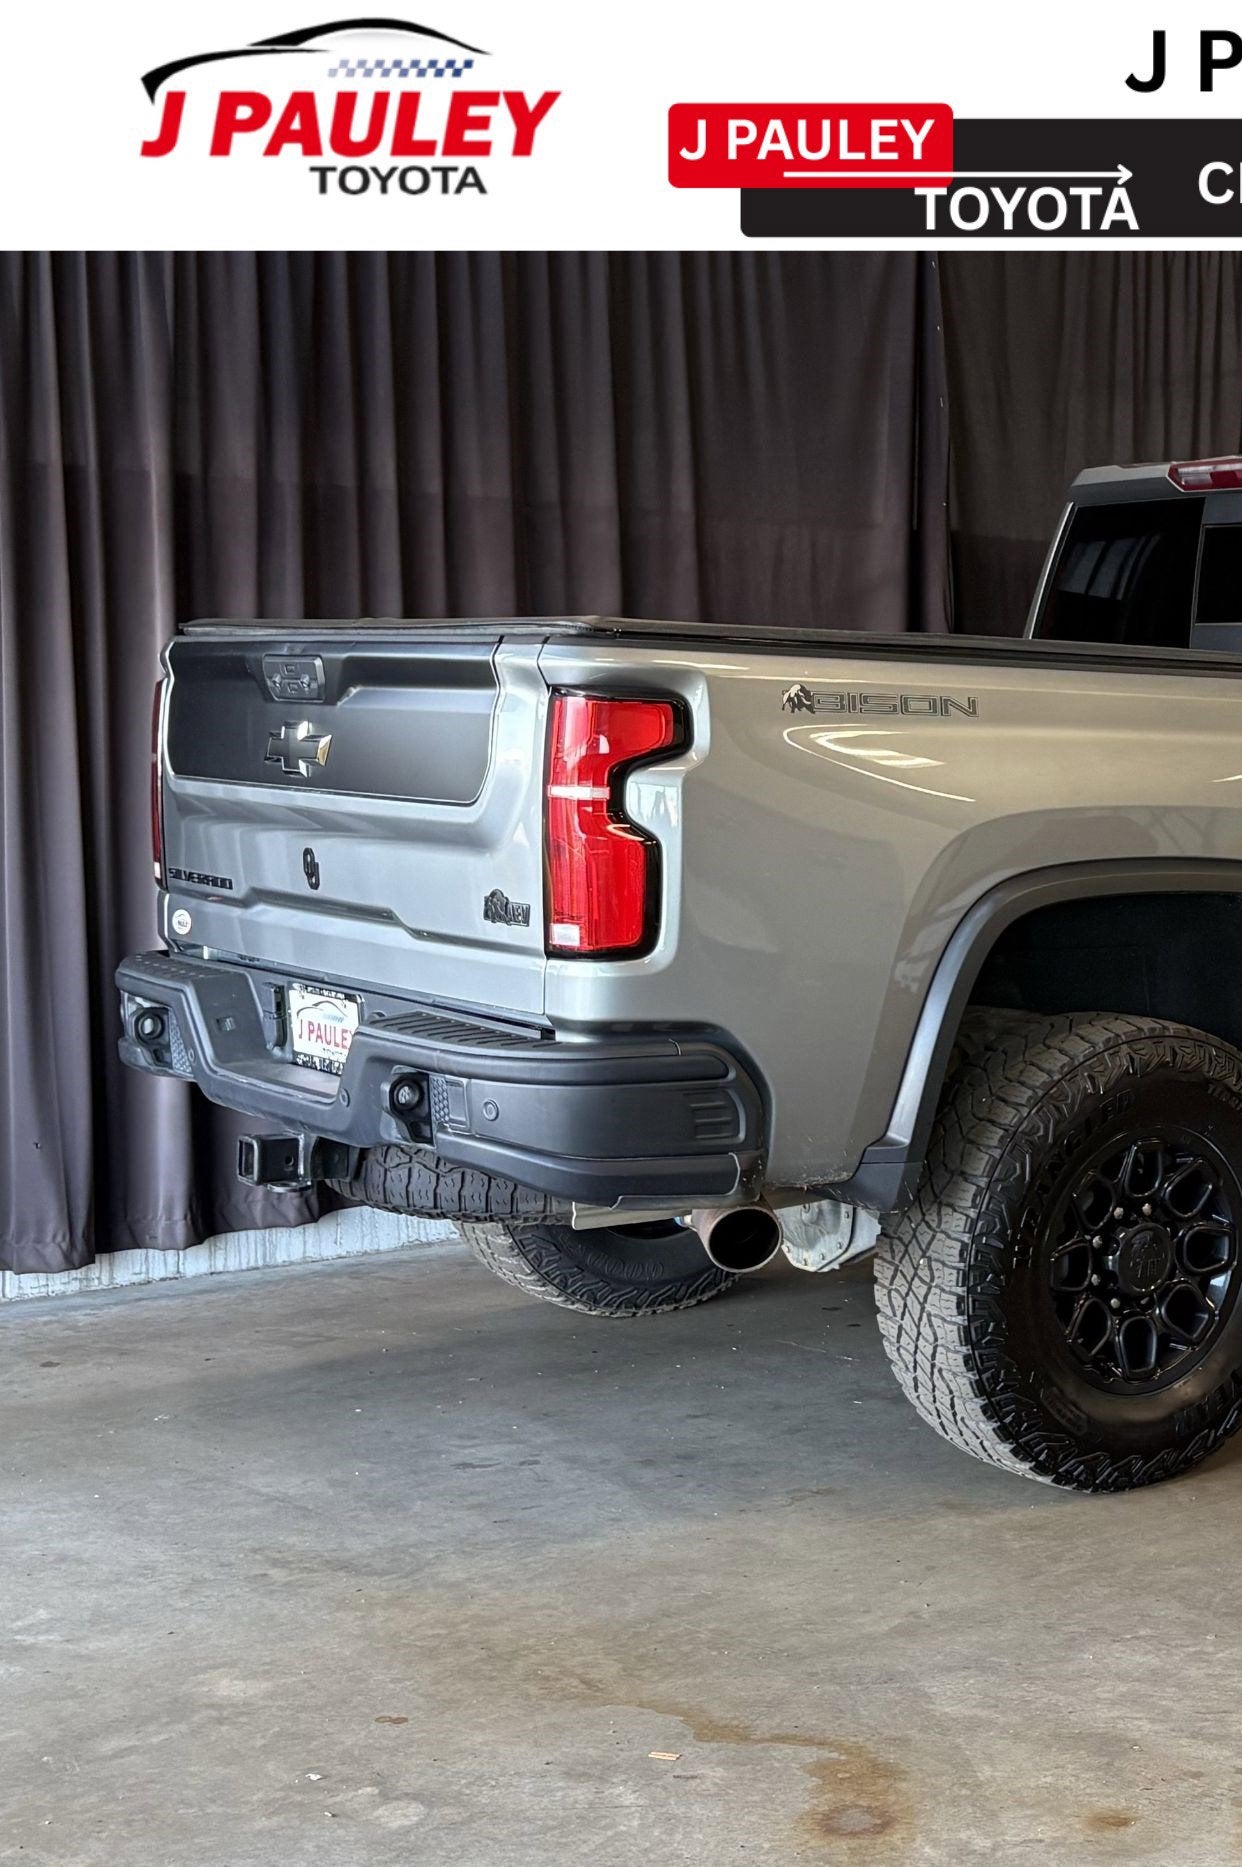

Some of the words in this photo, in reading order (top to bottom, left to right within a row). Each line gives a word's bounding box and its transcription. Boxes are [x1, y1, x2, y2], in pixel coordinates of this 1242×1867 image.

[812, 690, 980, 717] BISON
[168, 867, 234, 891] SILVERADO
[298, 1018, 303, 1040] J
